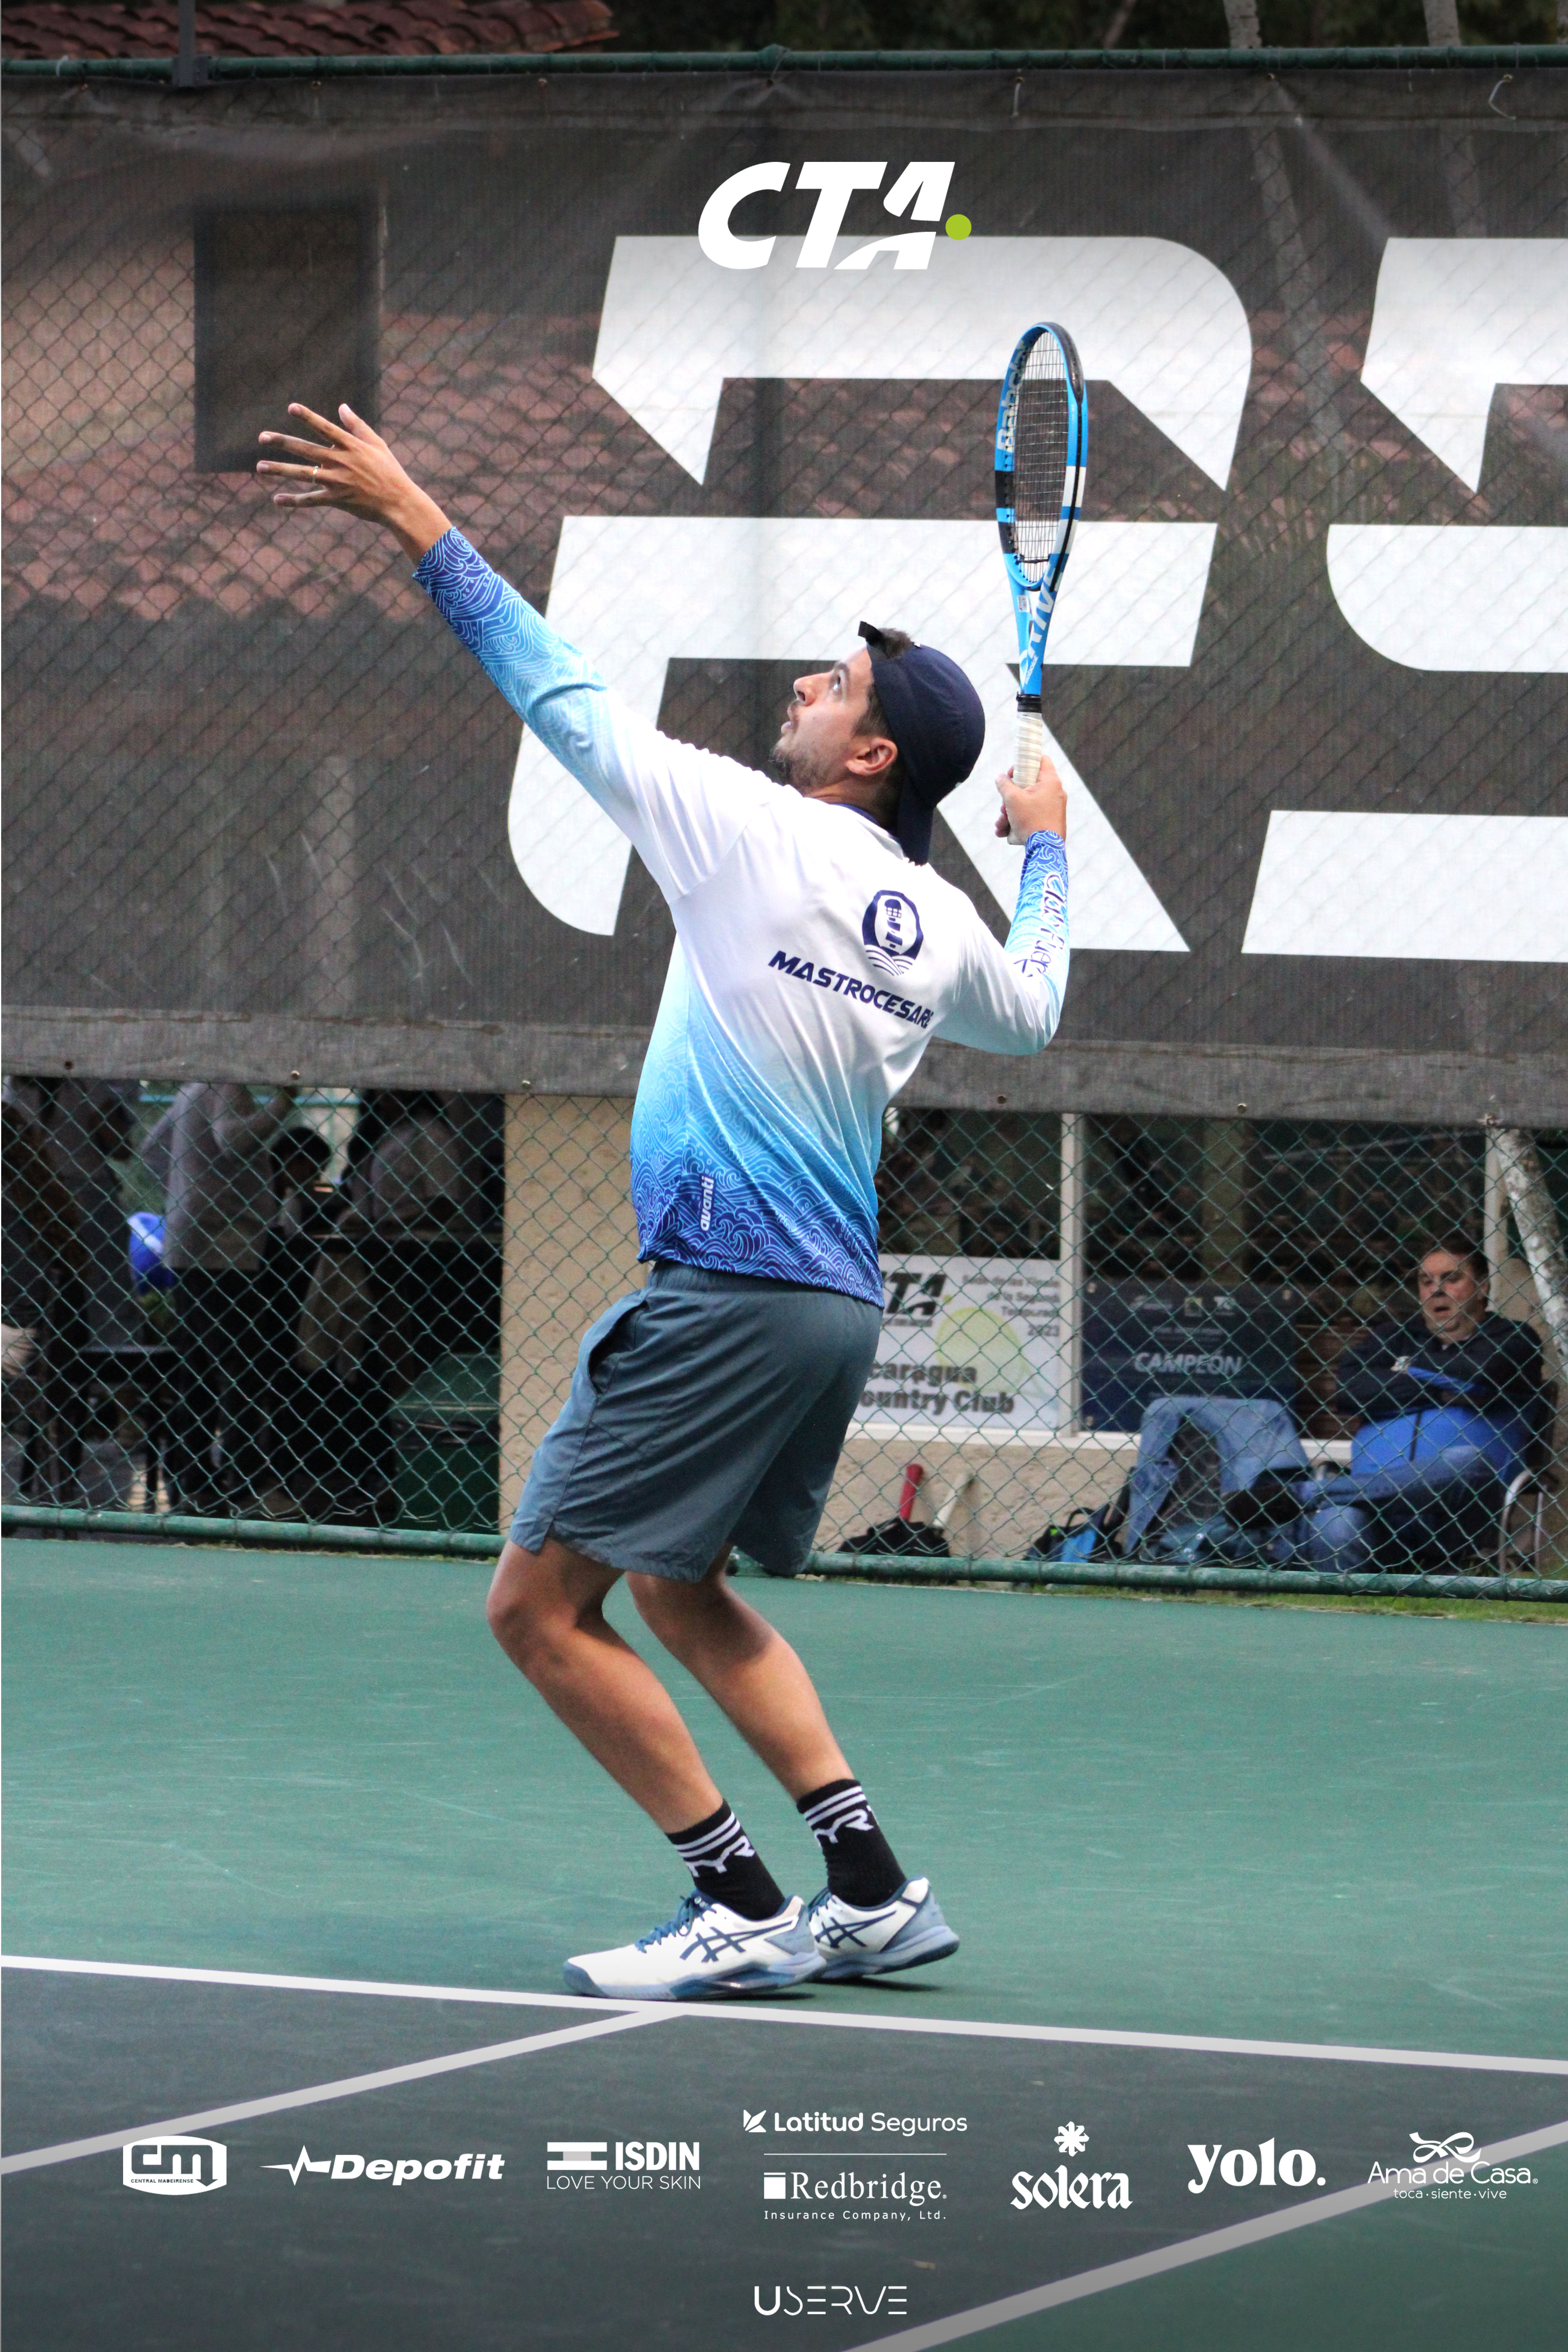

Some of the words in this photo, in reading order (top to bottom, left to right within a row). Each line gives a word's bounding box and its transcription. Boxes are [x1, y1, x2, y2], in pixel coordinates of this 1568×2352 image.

[700, 1176, 714, 1231] avanti
[881, 1271, 946, 1315] TA
[1135, 1349, 1243, 1374] CAMPEÓN
[868, 1363, 977, 1387] caragua
[861, 1389, 946, 1415] ountry
[954, 1390, 1014, 1414] Club
